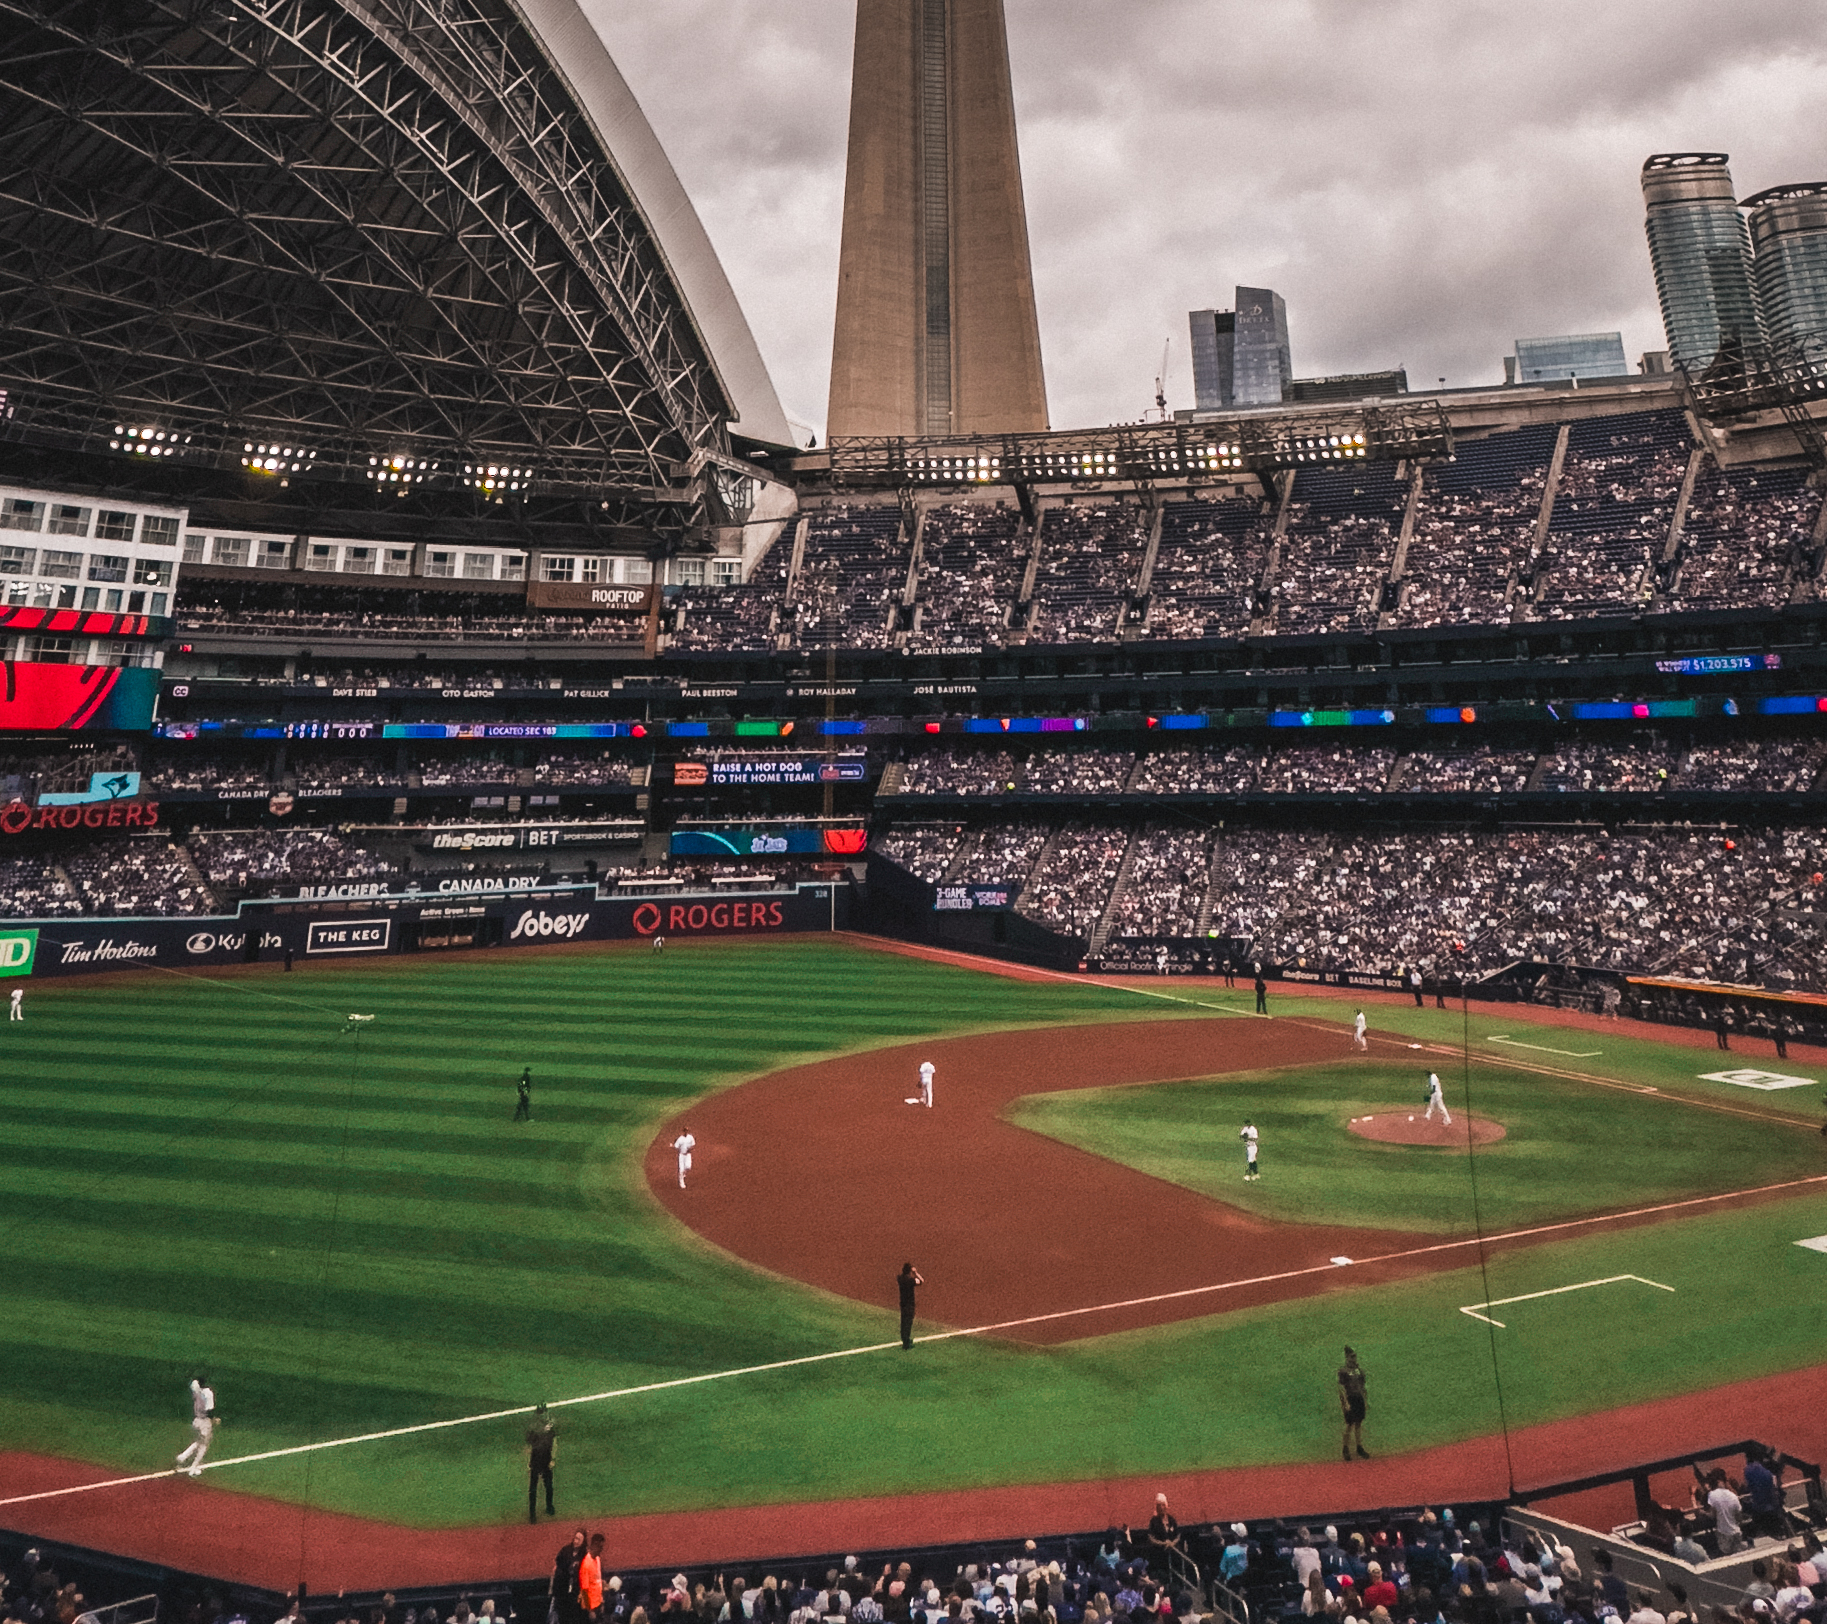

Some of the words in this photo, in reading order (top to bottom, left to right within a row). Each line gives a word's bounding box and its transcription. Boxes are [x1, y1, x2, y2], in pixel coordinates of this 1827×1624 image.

[592, 589, 645, 603] ROOFTOP
[914, 647, 940, 655] JACKIE
[941, 646, 982, 654] ROBINSON
[174, 687, 187, 696] CC
[333, 688, 353, 697] DAVE
[681, 689, 700, 697] PAUL
[798, 688, 814, 696] ROY
[816, 688, 857, 696] HALLADAY
[937, 685, 977, 694] BAUTISTA
[488, 726, 523, 736] LOCATED
[525, 726, 540, 735] SEC
[713, 763, 741, 772] RAISE
[745, 762, 752, 772] A
[755, 762, 777, 772] HOT
[780, 762, 802, 772] DOG
[713, 774, 726, 783] TO
[729, 774, 747, 783] THE
[751, 773, 781, 782] HOME
[785, 773, 814, 782] TEAM!
[218, 790, 252, 799] CANADA
[254, 790, 269, 799] DRY
[298, 788, 342, 797] BLEACHERS
[40, 802, 159, 828] ROGERS
[432, 833, 515, 848] theScore
[529, 831, 560, 846] BET
[438, 878, 505, 894] CANADA
[508, 876, 540, 890] DRY
[299, 883, 389, 900] BLEACHERS
[669, 901, 783, 929] ROGERS
[510, 909, 589, 939] Sobeys
[318, 931, 347, 943] THE
[351, 929, 380, 941] KEG
[0, 938, 31, 967] D
[61, 941, 93, 964] Tim
[92, 939, 158, 961] Hortons
[1100, 961, 1128, 971] Official
